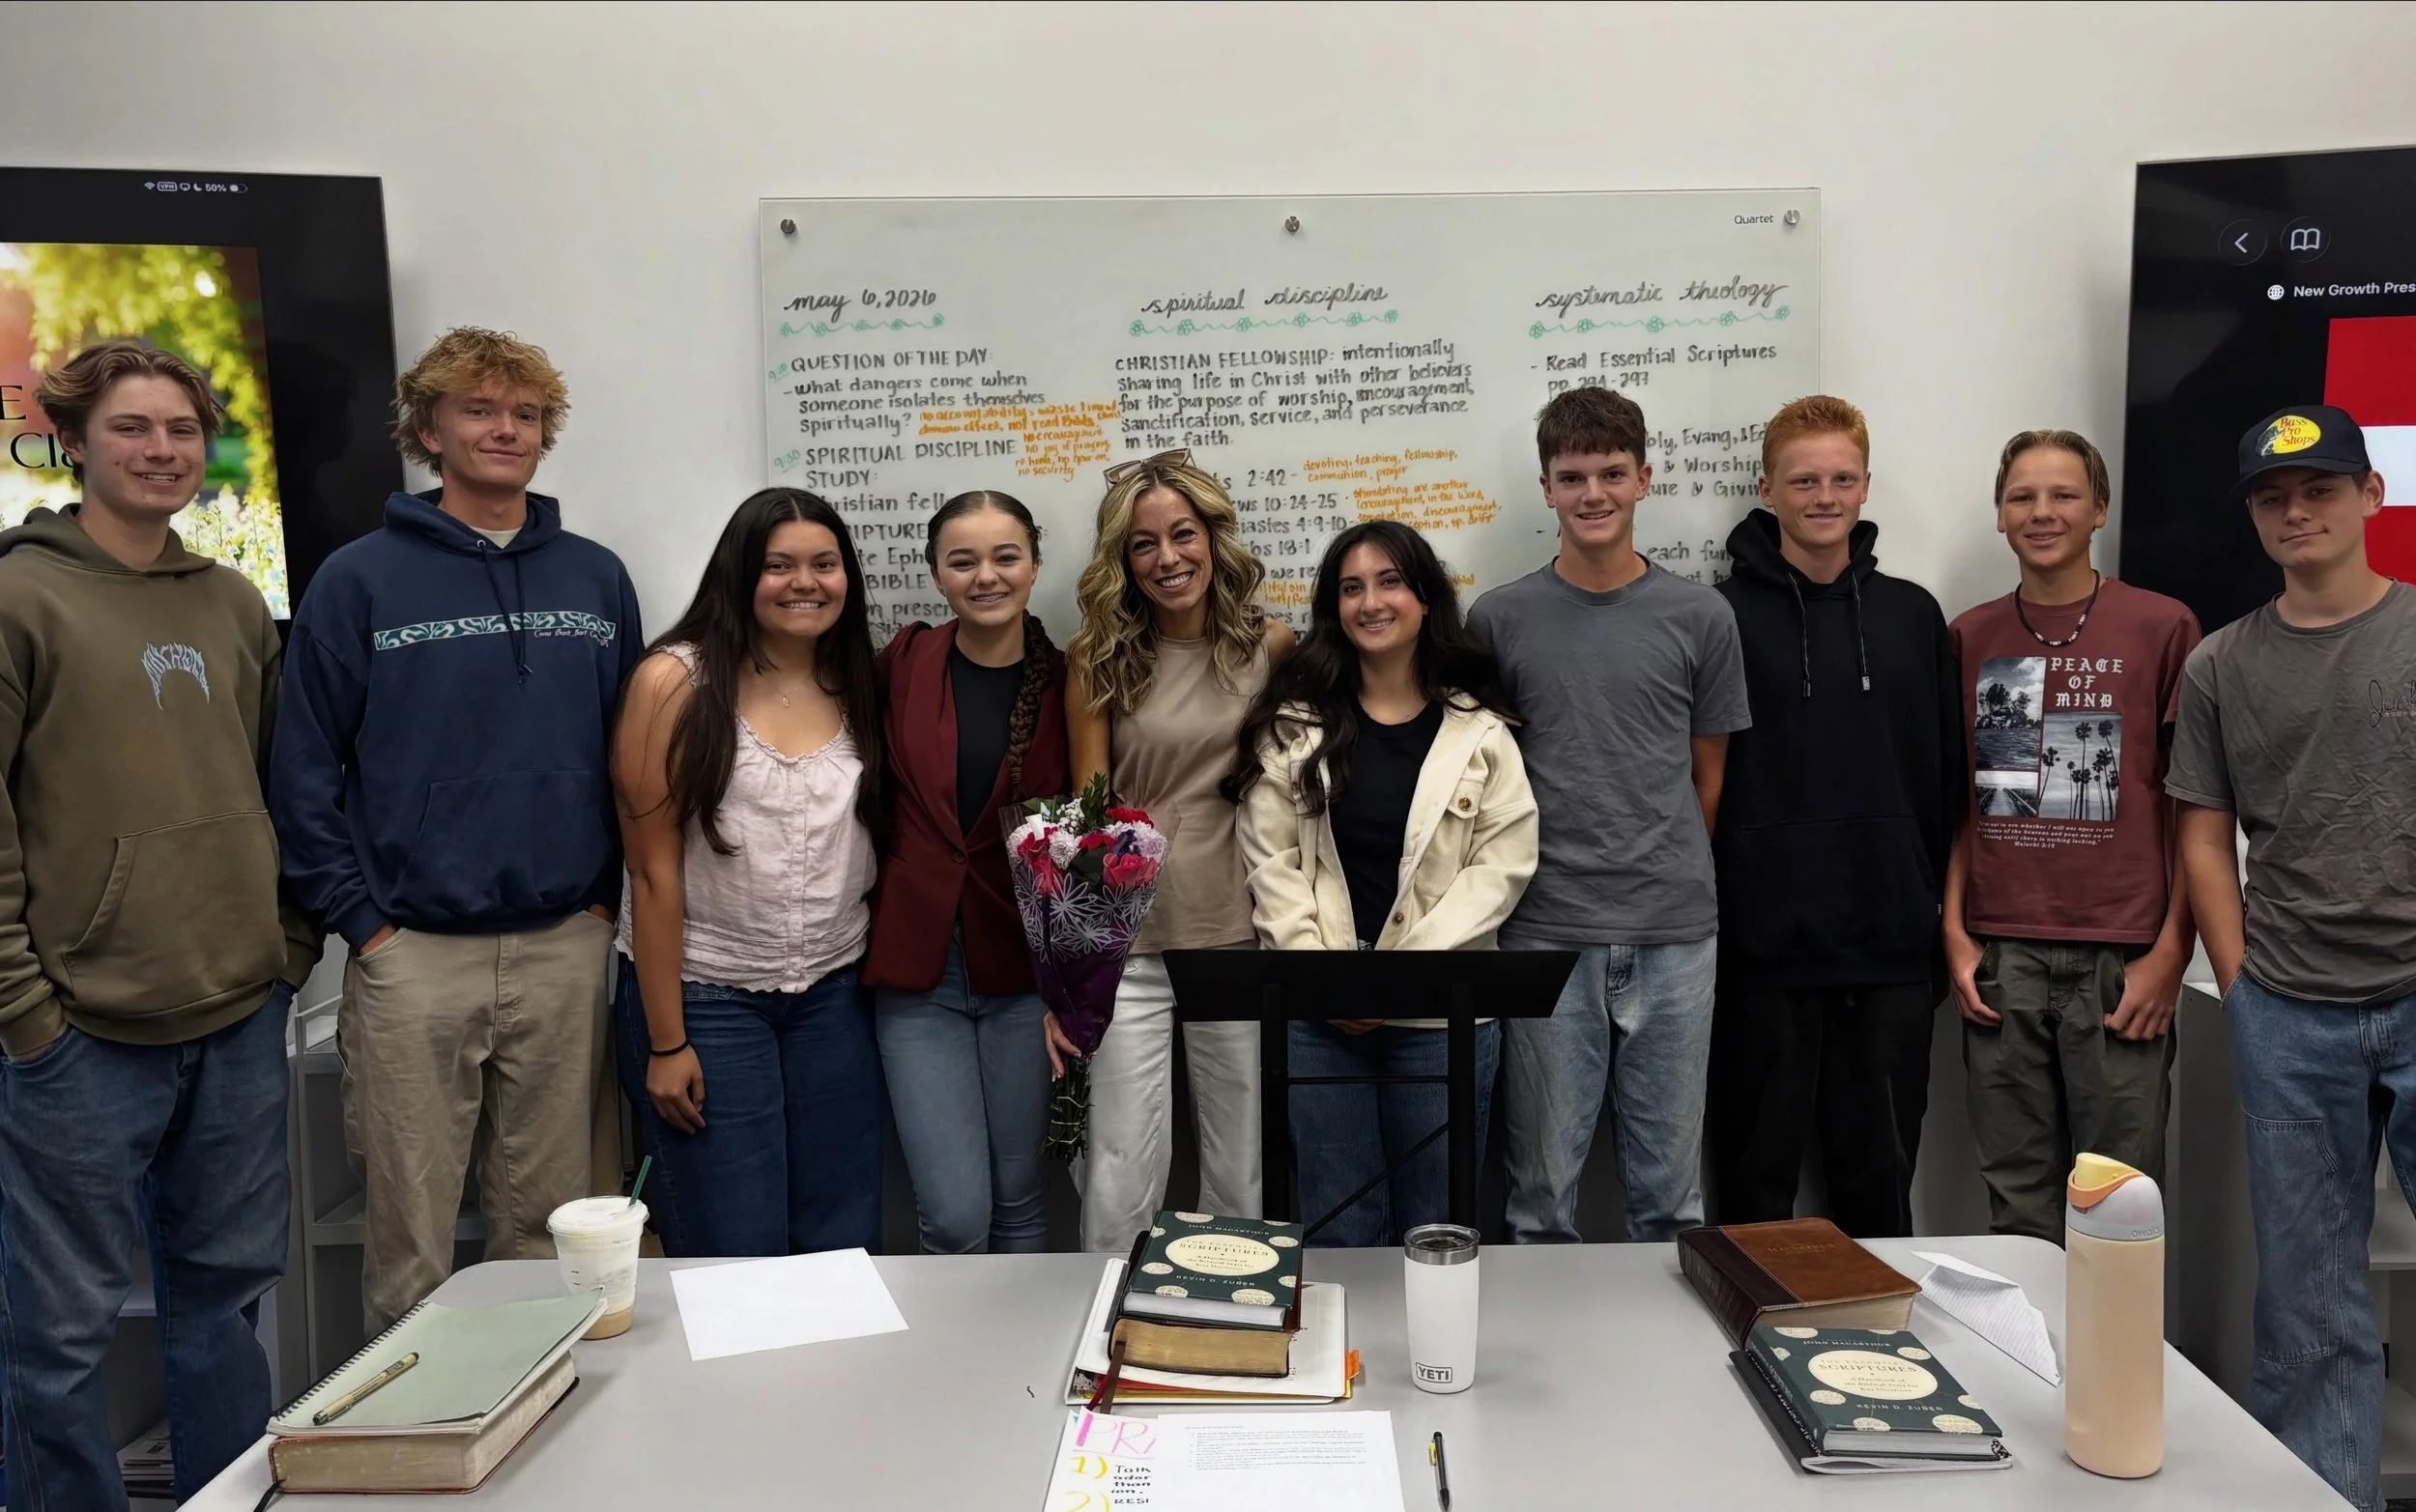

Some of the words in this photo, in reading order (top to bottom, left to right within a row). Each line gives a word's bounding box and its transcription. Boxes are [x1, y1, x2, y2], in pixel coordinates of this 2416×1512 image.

[205, 184, 227, 192] 50%
[1734, 214, 1774, 225] Quartet
[1536, 281, 1663, 319] systematic
[1680, 274, 1790, 308] theology
[2293, 286, 2324, 298] New
[2328, 283, 2379, 298] Growth
[784, 293, 851, 324] may
[1141, 289, 1245, 319] spiritual
[1264, 282, 1389, 311] discipline
[791, 353, 885, 373] QUESTION
[893, 351, 914, 367] OF
[916, 350, 951, 366] THE
[1115, 354, 1211, 371] CHRISTIAN
[1218, 349, 1336, 369] FELLOWSHIP:
[1342, 339, 1455, 363] intentionally
[1546, 353, 1588, 372] Read
[1600, 347, 1676, 368] Essential
[1687, 344, 1777, 367] Scriptures
[849, 375, 922, 395] dangers
[930, 376, 973, 388] come
[981, 373, 1027, 388] when
[1117, 375, 1183, 396] sharing
[1193, 372, 1222, 390] life
[1229, 374, 1245, 388] in
[1251, 370, 1309, 388] Christ
[1315, 368, 1352, 385] with
[1360, 364, 1401, 384] other
[1408, 361, 1473, 382] believers
[799, 395, 884, 414] someone
[889, 392, 956, 410] isolates
[1118, 394, 1143, 414] for
[1147, 392, 1174, 411] the
[1177, 393, 1244, 414] purpose
[1249, 388, 1268, 407] of
[799, 413, 912, 438] spiritually?
[1121, 412, 1246, 435] sanctification,
[1251, 406, 1319, 426] service,
[1322, 405, 1353, 421] and
[1361, 398, 1469, 424] perseverance
[2281, 415, 2307, 427] Bass
[2282, 426, 2302, 436] Pro
[2283, 434, 2315, 447] Shops
[1125, 433, 1141, 449] in
[1146, 433, 1176, 449] the
[805, 445, 906, 467] SPIRITUAL
[914, 440, 1019, 459] DISCIPLINE
[1248, 469, 1288, 488] 2:42
[1713, 480, 1760, 498] Givin
[822, 492, 899, 512] hristian
[906, 492, 945, 511] fell
[1264, 493, 1338, 512] 10:24-25
[1279, 538, 1310, 556] 18:1
[888, 547, 925, 573] Eph
[865, 574, 929, 590] BIBLE
[1271, 567, 1294, 580] we
[2050, 657, 2124, 673] PEACE
[2068, 675, 2096, 690] OF
[2056, 693, 2113, 708] MIND
[1418, 1366, 1450, 1381] YETI
[1077, 1412, 1157, 1455] PR
